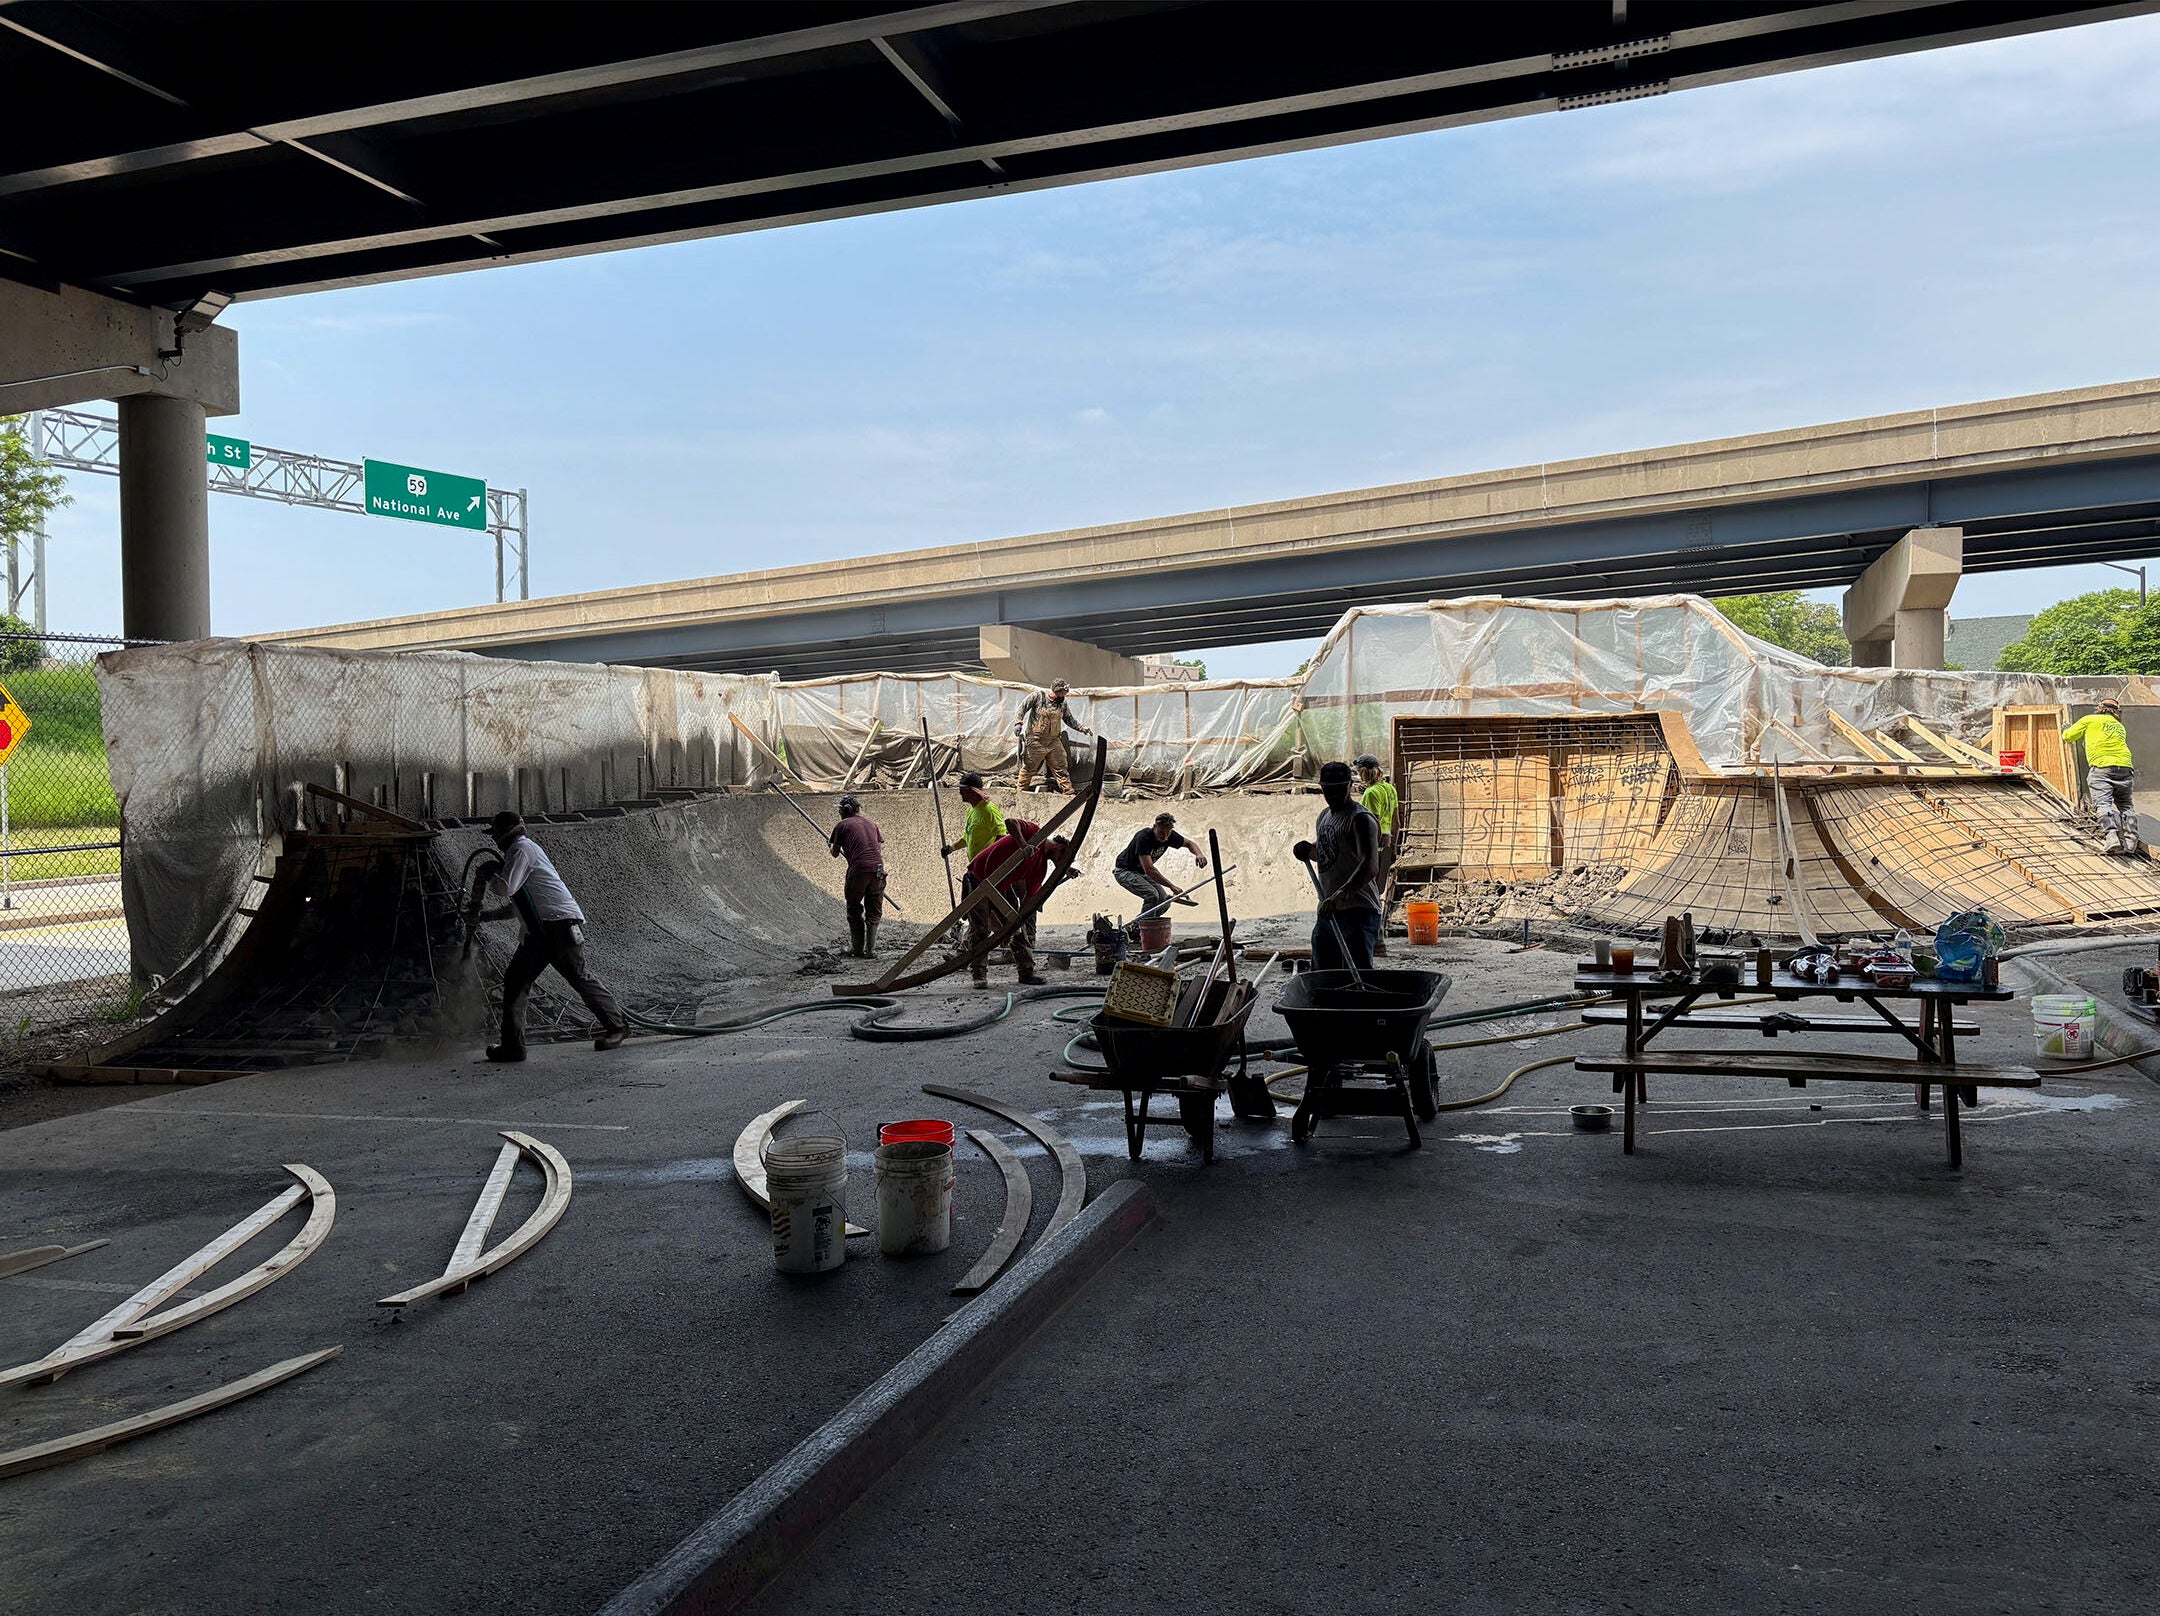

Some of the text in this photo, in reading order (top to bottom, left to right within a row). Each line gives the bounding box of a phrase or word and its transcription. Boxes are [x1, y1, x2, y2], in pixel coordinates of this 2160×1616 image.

[224, 444, 241, 460] St
[409, 479, 425, 493] 59
[372, 495, 460, 521] National Ave
